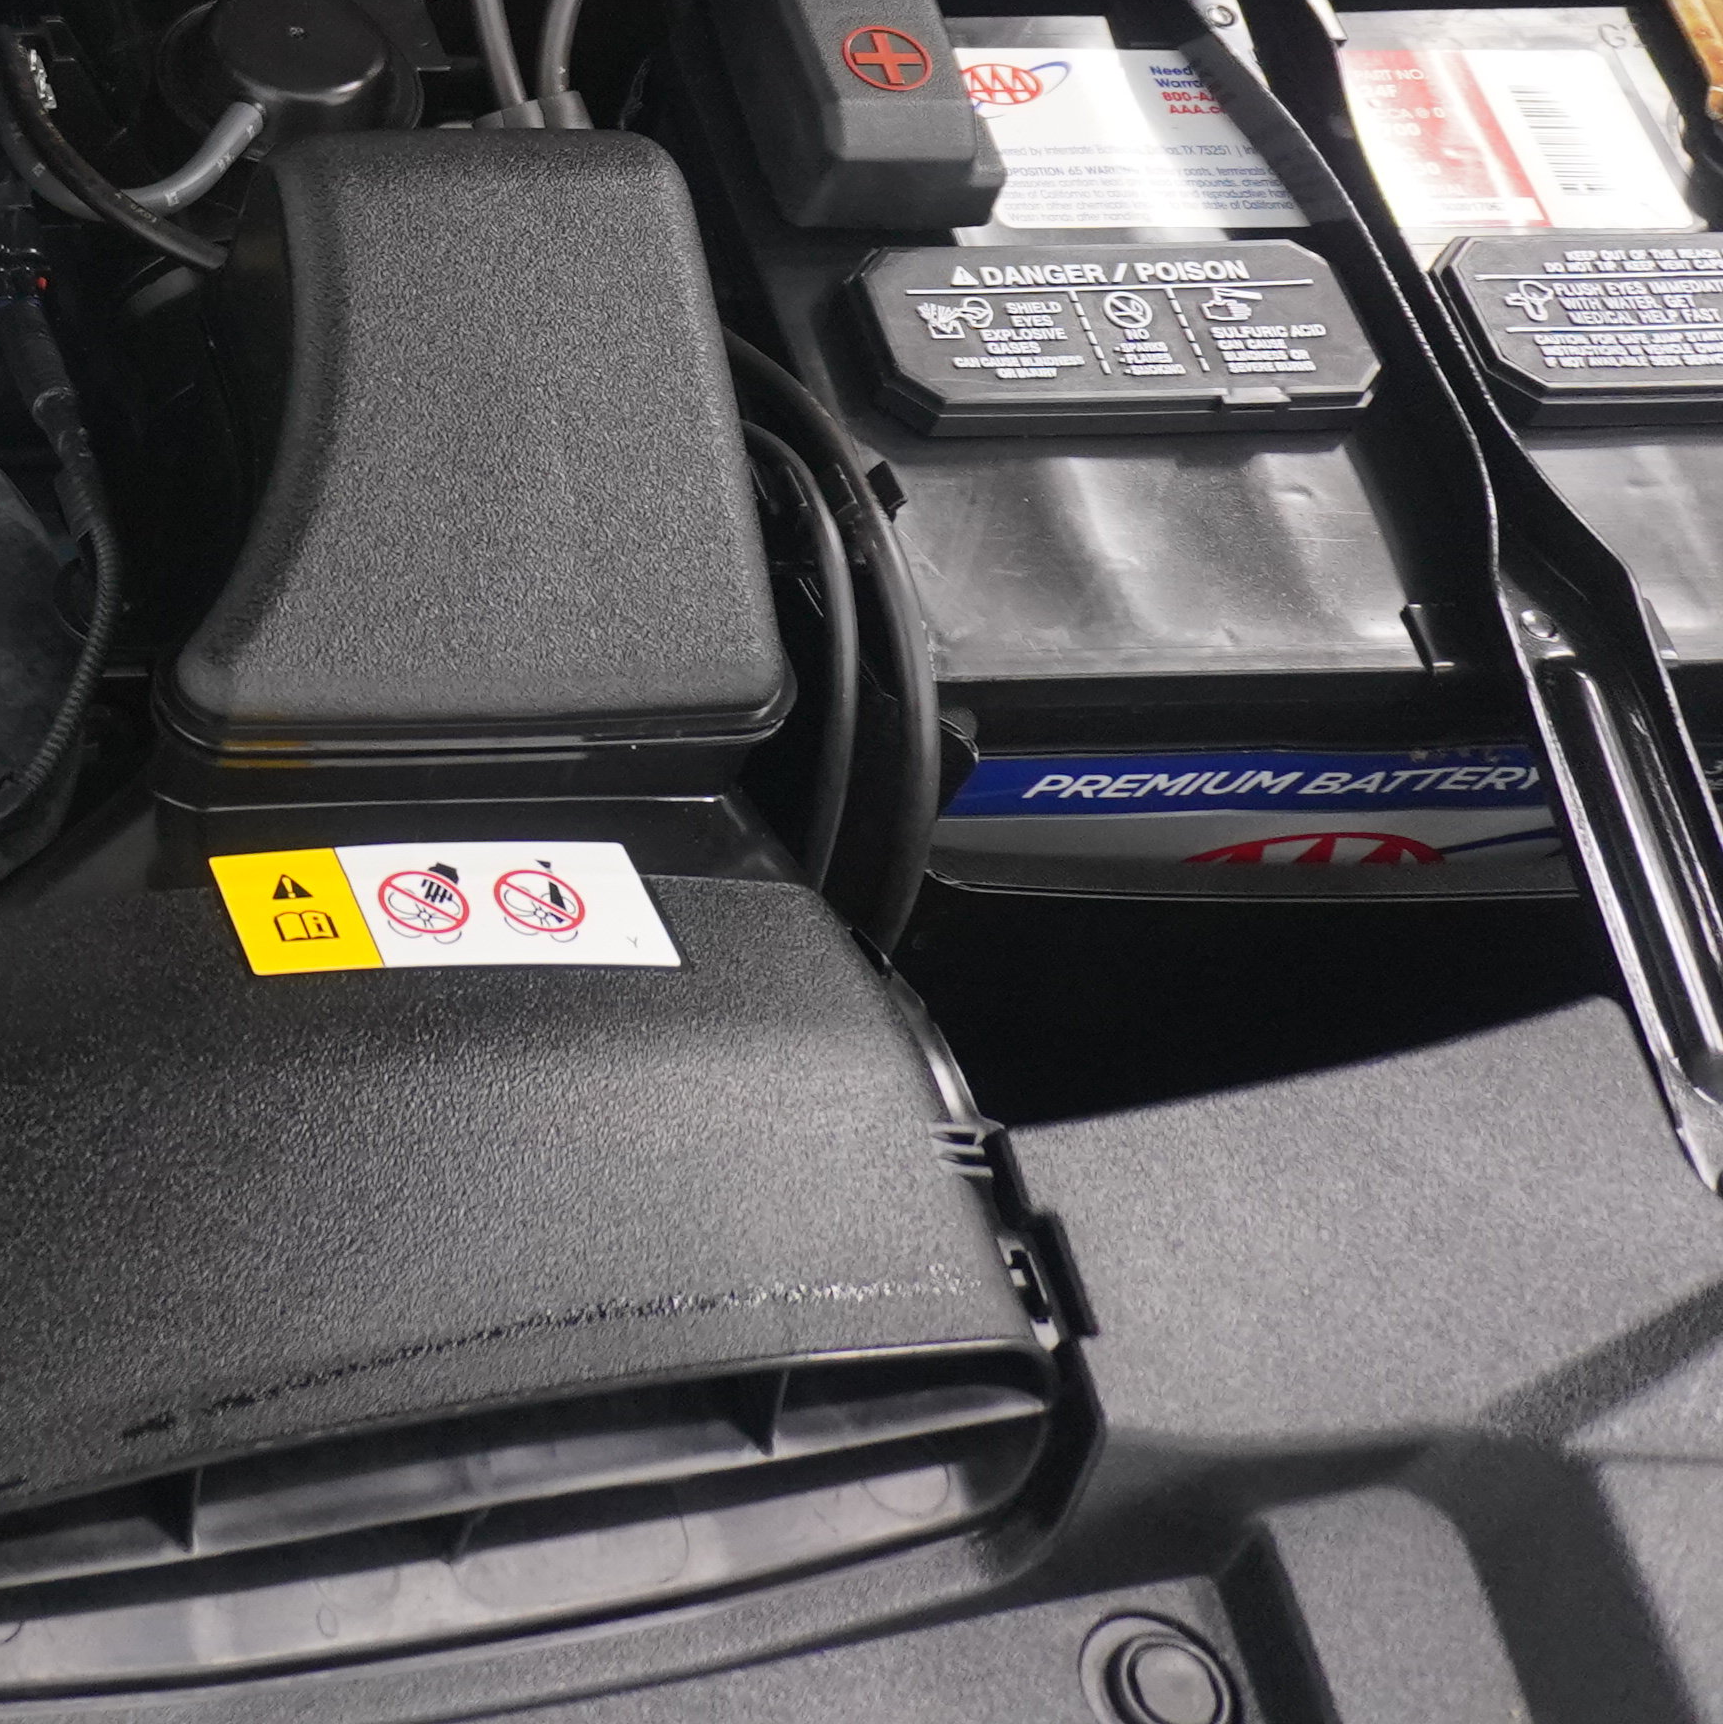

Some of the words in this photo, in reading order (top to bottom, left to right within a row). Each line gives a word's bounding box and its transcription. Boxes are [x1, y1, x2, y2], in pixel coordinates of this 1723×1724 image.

[1149, 65, 1195, 76] Need
[1068, 166, 1084, 176] 65
[978, 263, 1109, 287] DANGER
[1133, 259, 1251, 282] POISON
[1551, 282, 1605, 296] FLUSH
[1605, 281, 1647, 296] EYES
[1647, 279, 1723, 295] IMMEDIAT
[1004, 301, 1064, 315] SHIELD
[1557, 296, 1605, 310] WITH
[1663, 294, 1696, 309] GET
[1009, 314, 1055, 328] EYES
[1566, 309, 1637, 324] MEDICAL
[1638, 309, 1680, 324] HELP
[1681, 307, 1721, 323] FAST
[980, 327, 1069, 342] EXPLOSIVE
[1124, 328, 1151, 342] NO
[1209, 326, 1289, 339] SULFURIC
[1290, 324, 1328, 338] ACID
[985, 341, 1043, 355] GASES
[1217, 339, 1245, 351] CAN
[1246, 338, 1289, 350] CAUSE
[1022, 770, 1304, 800] PREMIUM
[1297, 765, 1540, 797] BATTERY
